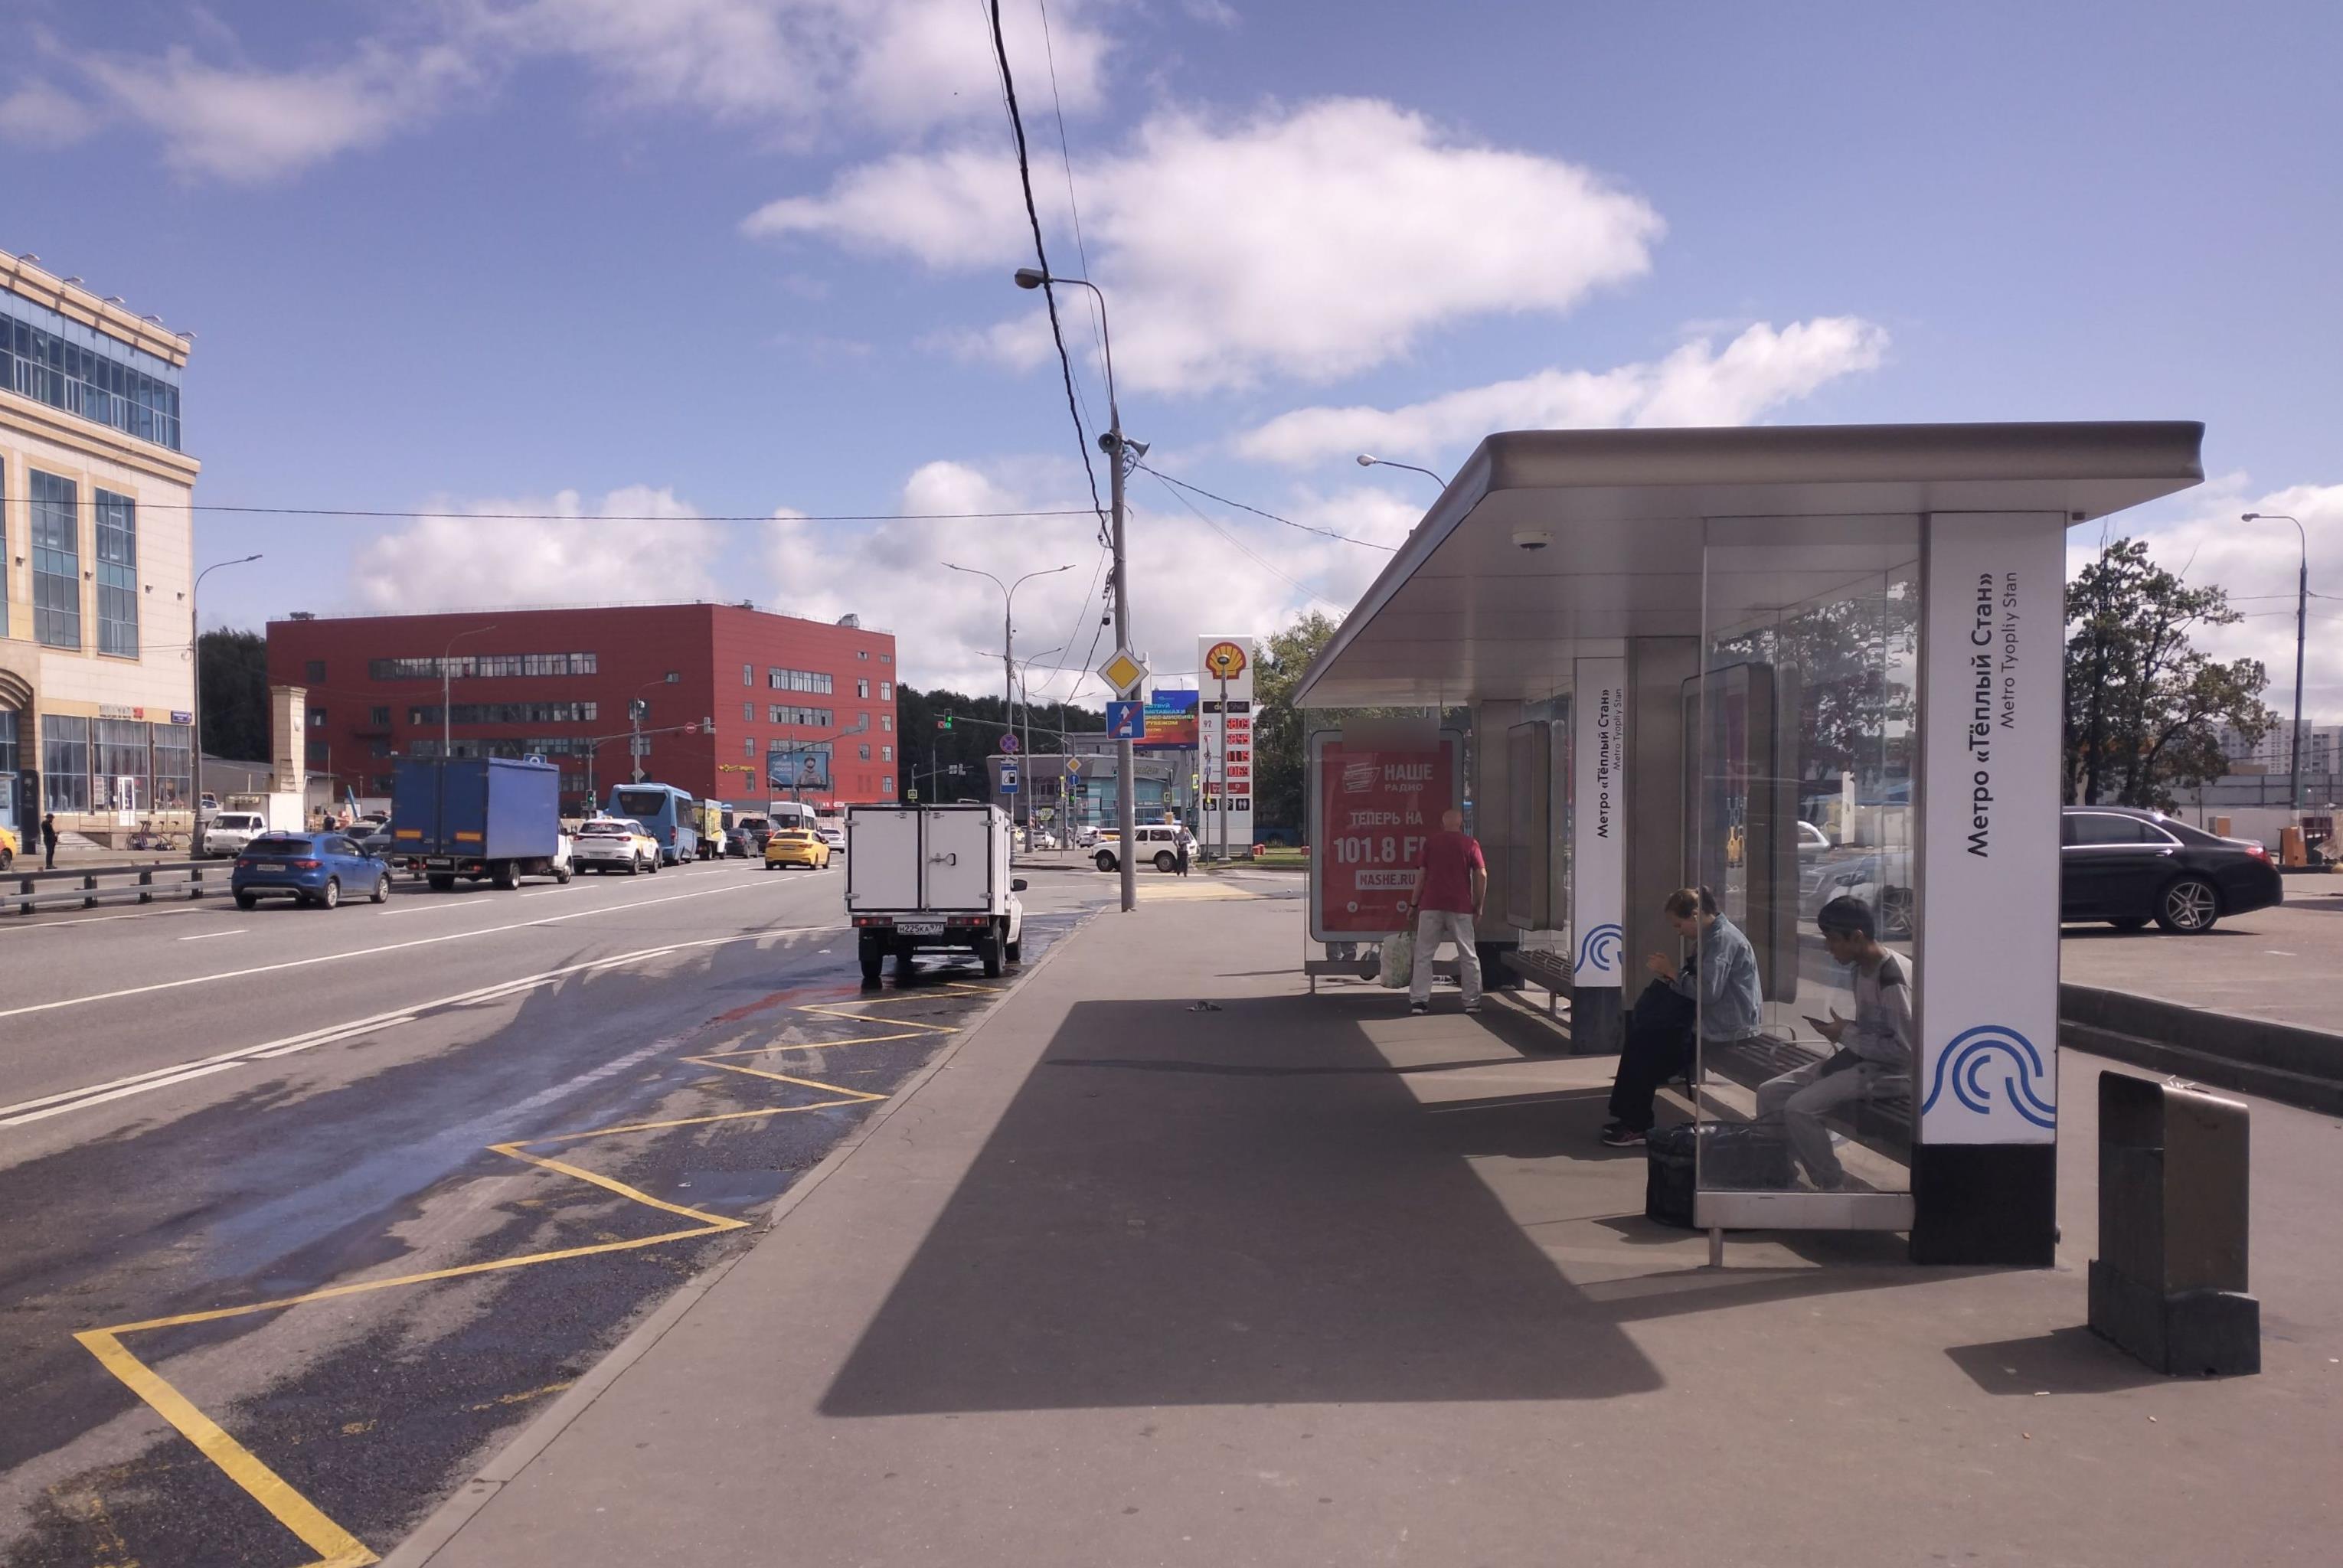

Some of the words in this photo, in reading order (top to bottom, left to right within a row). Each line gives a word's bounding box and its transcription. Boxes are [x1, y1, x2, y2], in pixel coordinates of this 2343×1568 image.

[1970, 573, 1993, 646] Стан»
[2003, 572, 2018, 608] Stan
[2002, 612, 2020, 673] Tyopliy
[1597, 689, 1609, 728] Стан»
[1614, 688, 1622, 708] Stan
[1968, 655, 1992, 763] «Тёплый
[2001, 678, 2015, 729] Metro
[1384, 763, 1434, 781] НАШЕ
[1597, 732, 1609, 789] «Тёплый
[1384, 783, 1423, 793] РАДИО
[1350, 811, 1400, 825] ТЕПЕРЬ
[1405, 811, 1423, 825] НА
[1596, 792, 1611, 839] Метро
[1968, 771, 1994, 858] Метро
[1333, 836, 1396, 864] 101.8
[1360, 874, 1416, 886] NASHE.RU
